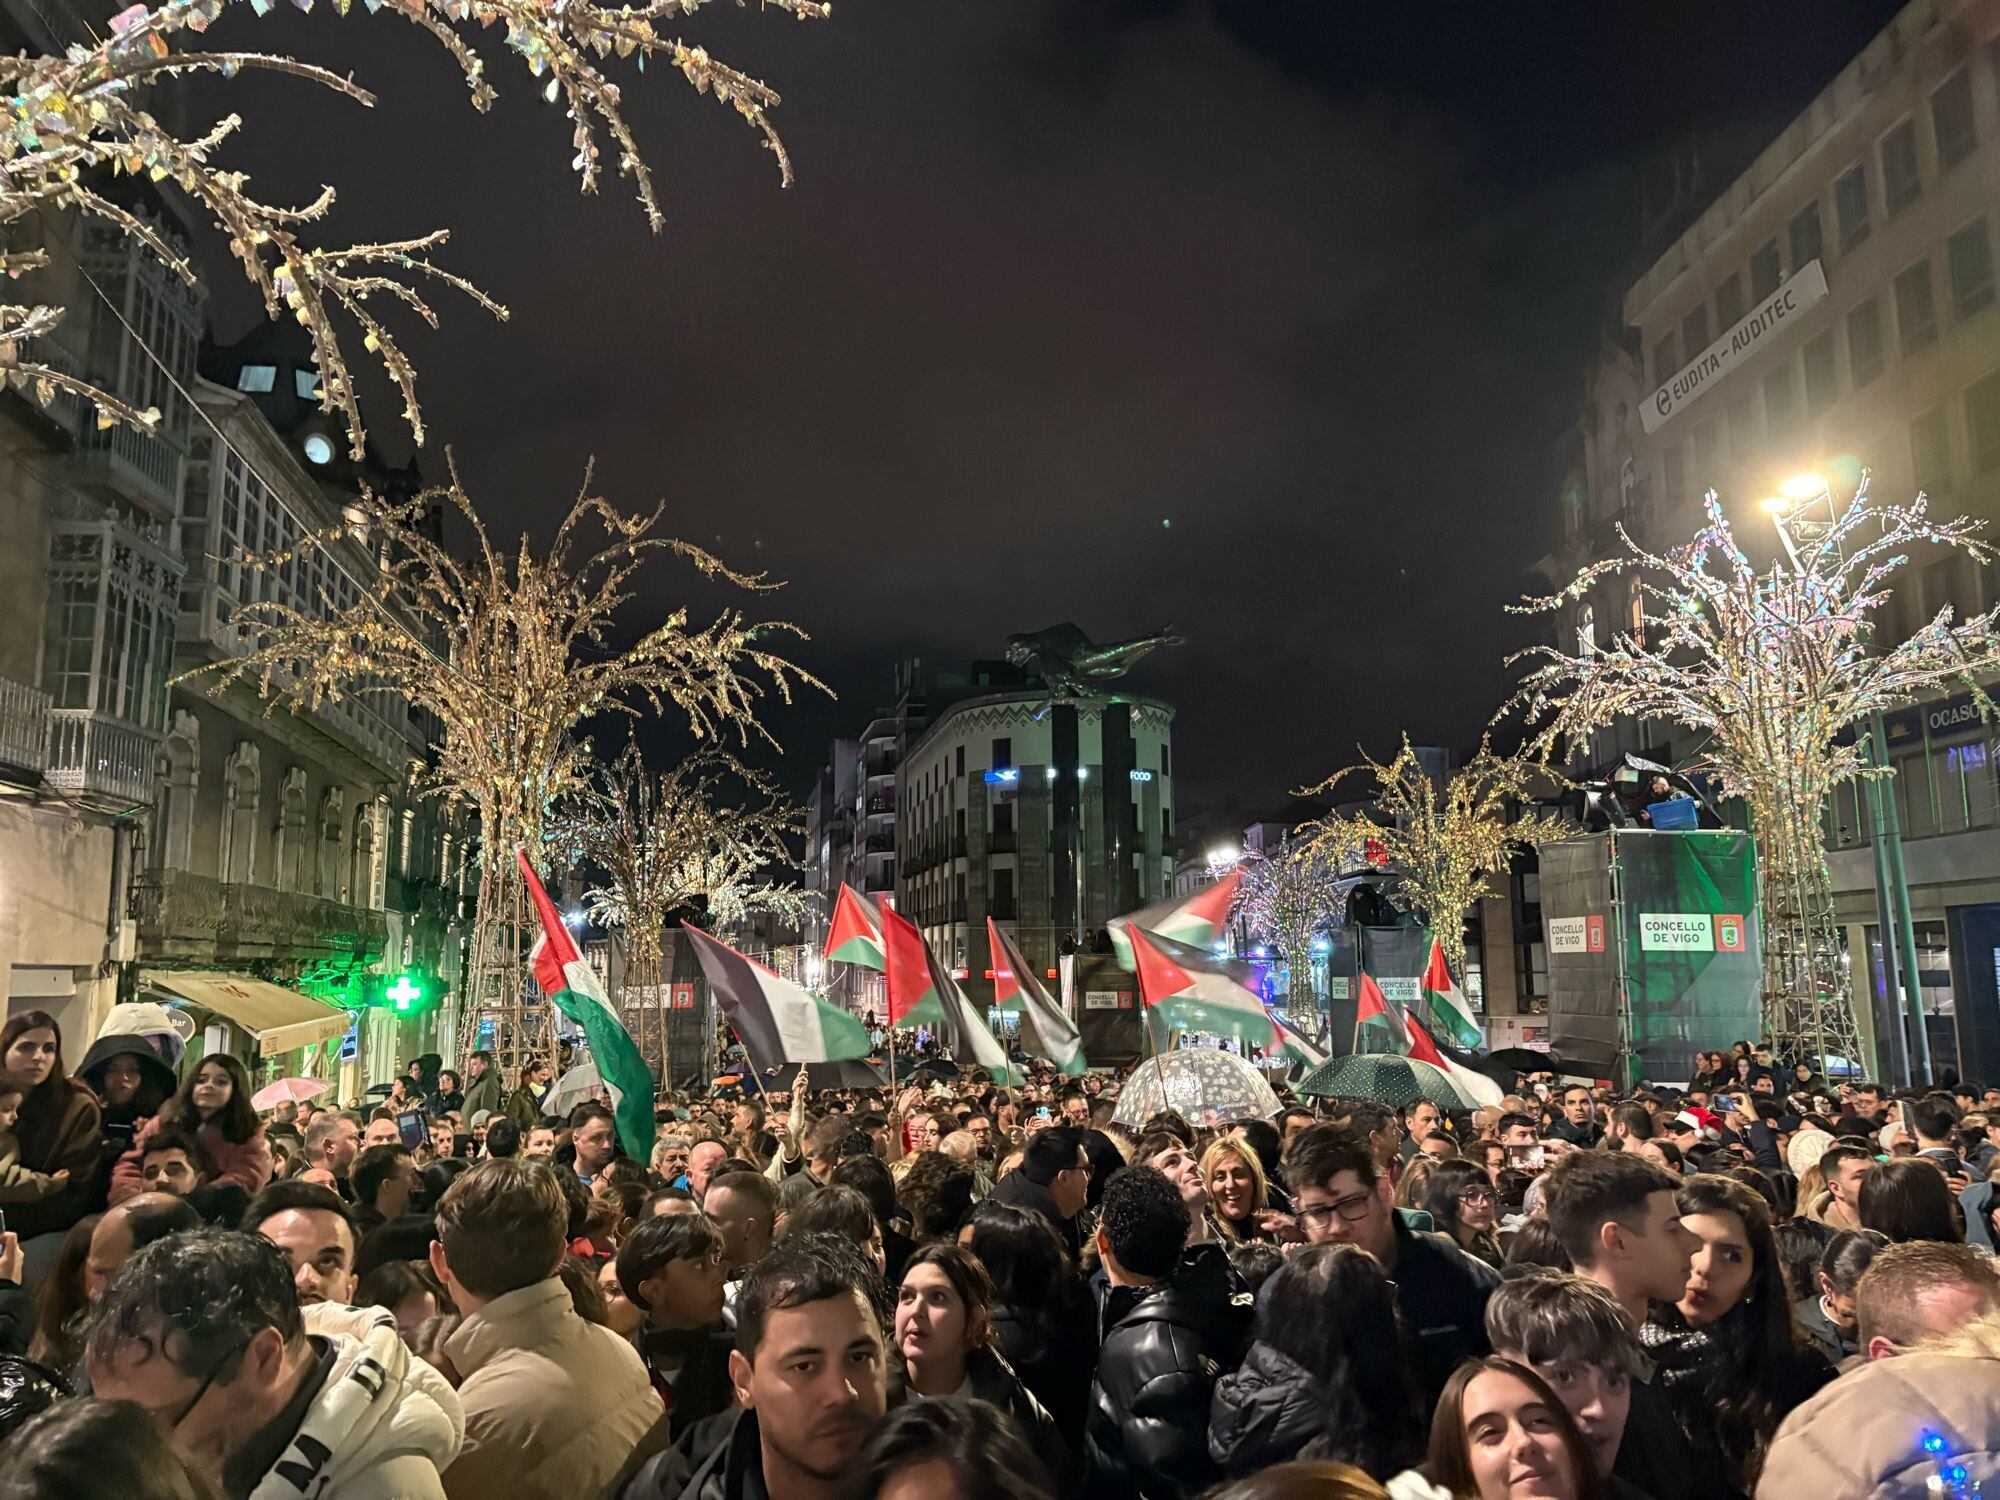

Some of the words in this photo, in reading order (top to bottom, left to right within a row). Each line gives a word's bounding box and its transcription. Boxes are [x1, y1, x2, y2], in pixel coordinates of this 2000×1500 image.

[1673, 353, 1720, 400] EUDITA
[1732, 290, 1796, 355] AUDITEC
[1551, 924, 1583, 935] CONCELLO
[1645, 922, 1706, 931] CONCELLO
[1555, 937, 1564, 946] DE
[1565, 936, 1580, 945] VIGO
[1653, 934, 1668, 943] DE
[1673, 934, 1699, 943] VIGO
[171, 1019, 186, 1027] Bar
